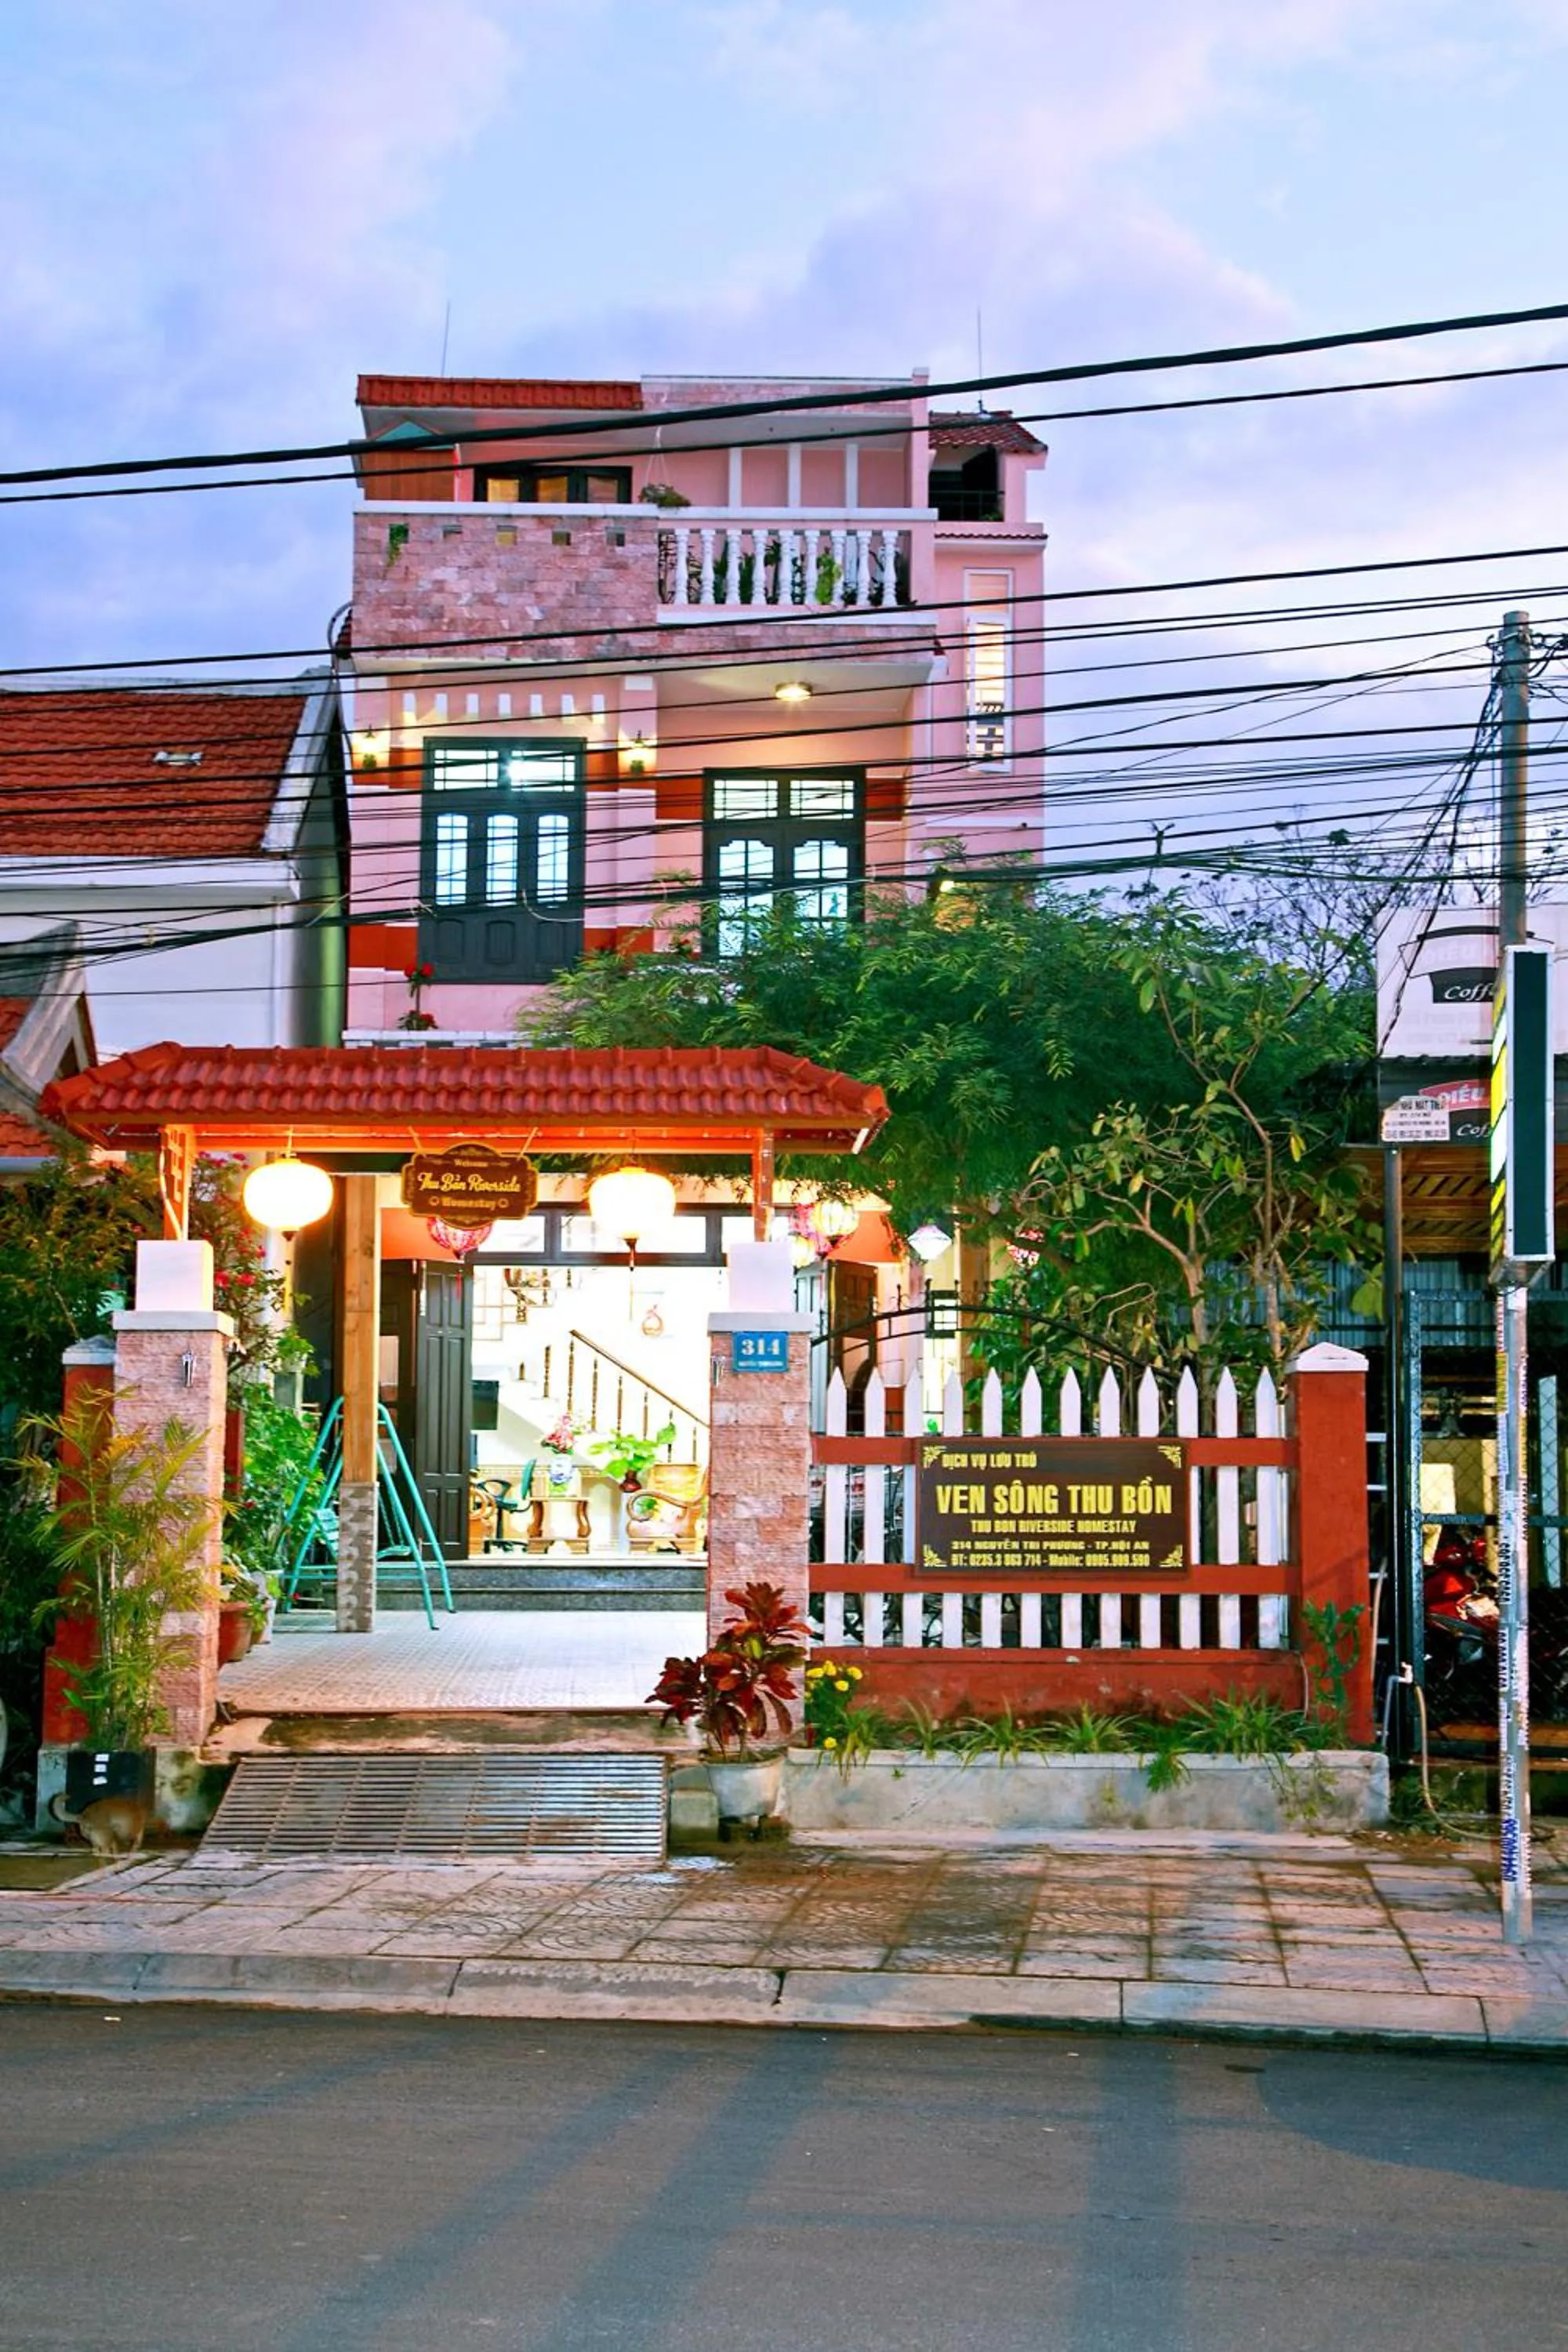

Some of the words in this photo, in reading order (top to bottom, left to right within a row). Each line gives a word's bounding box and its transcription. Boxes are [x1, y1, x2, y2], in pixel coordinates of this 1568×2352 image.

[441, 1196, 496, 1210] Homestay
[741, 1338, 780, 1356] 314
[936, 1485, 985, 1514] VEN
[993, 1479, 1058, 1514] SÔNG
[1066, 1485, 1113, 1514] THU
[1121, 1475, 1172, 1514] BỒN
[971, 1519, 992, 1533] THU
[1018, 1519, 1075, 1533] RIVERSIDE
[1076, 1519, 1136, 1533] HOMESTAY
